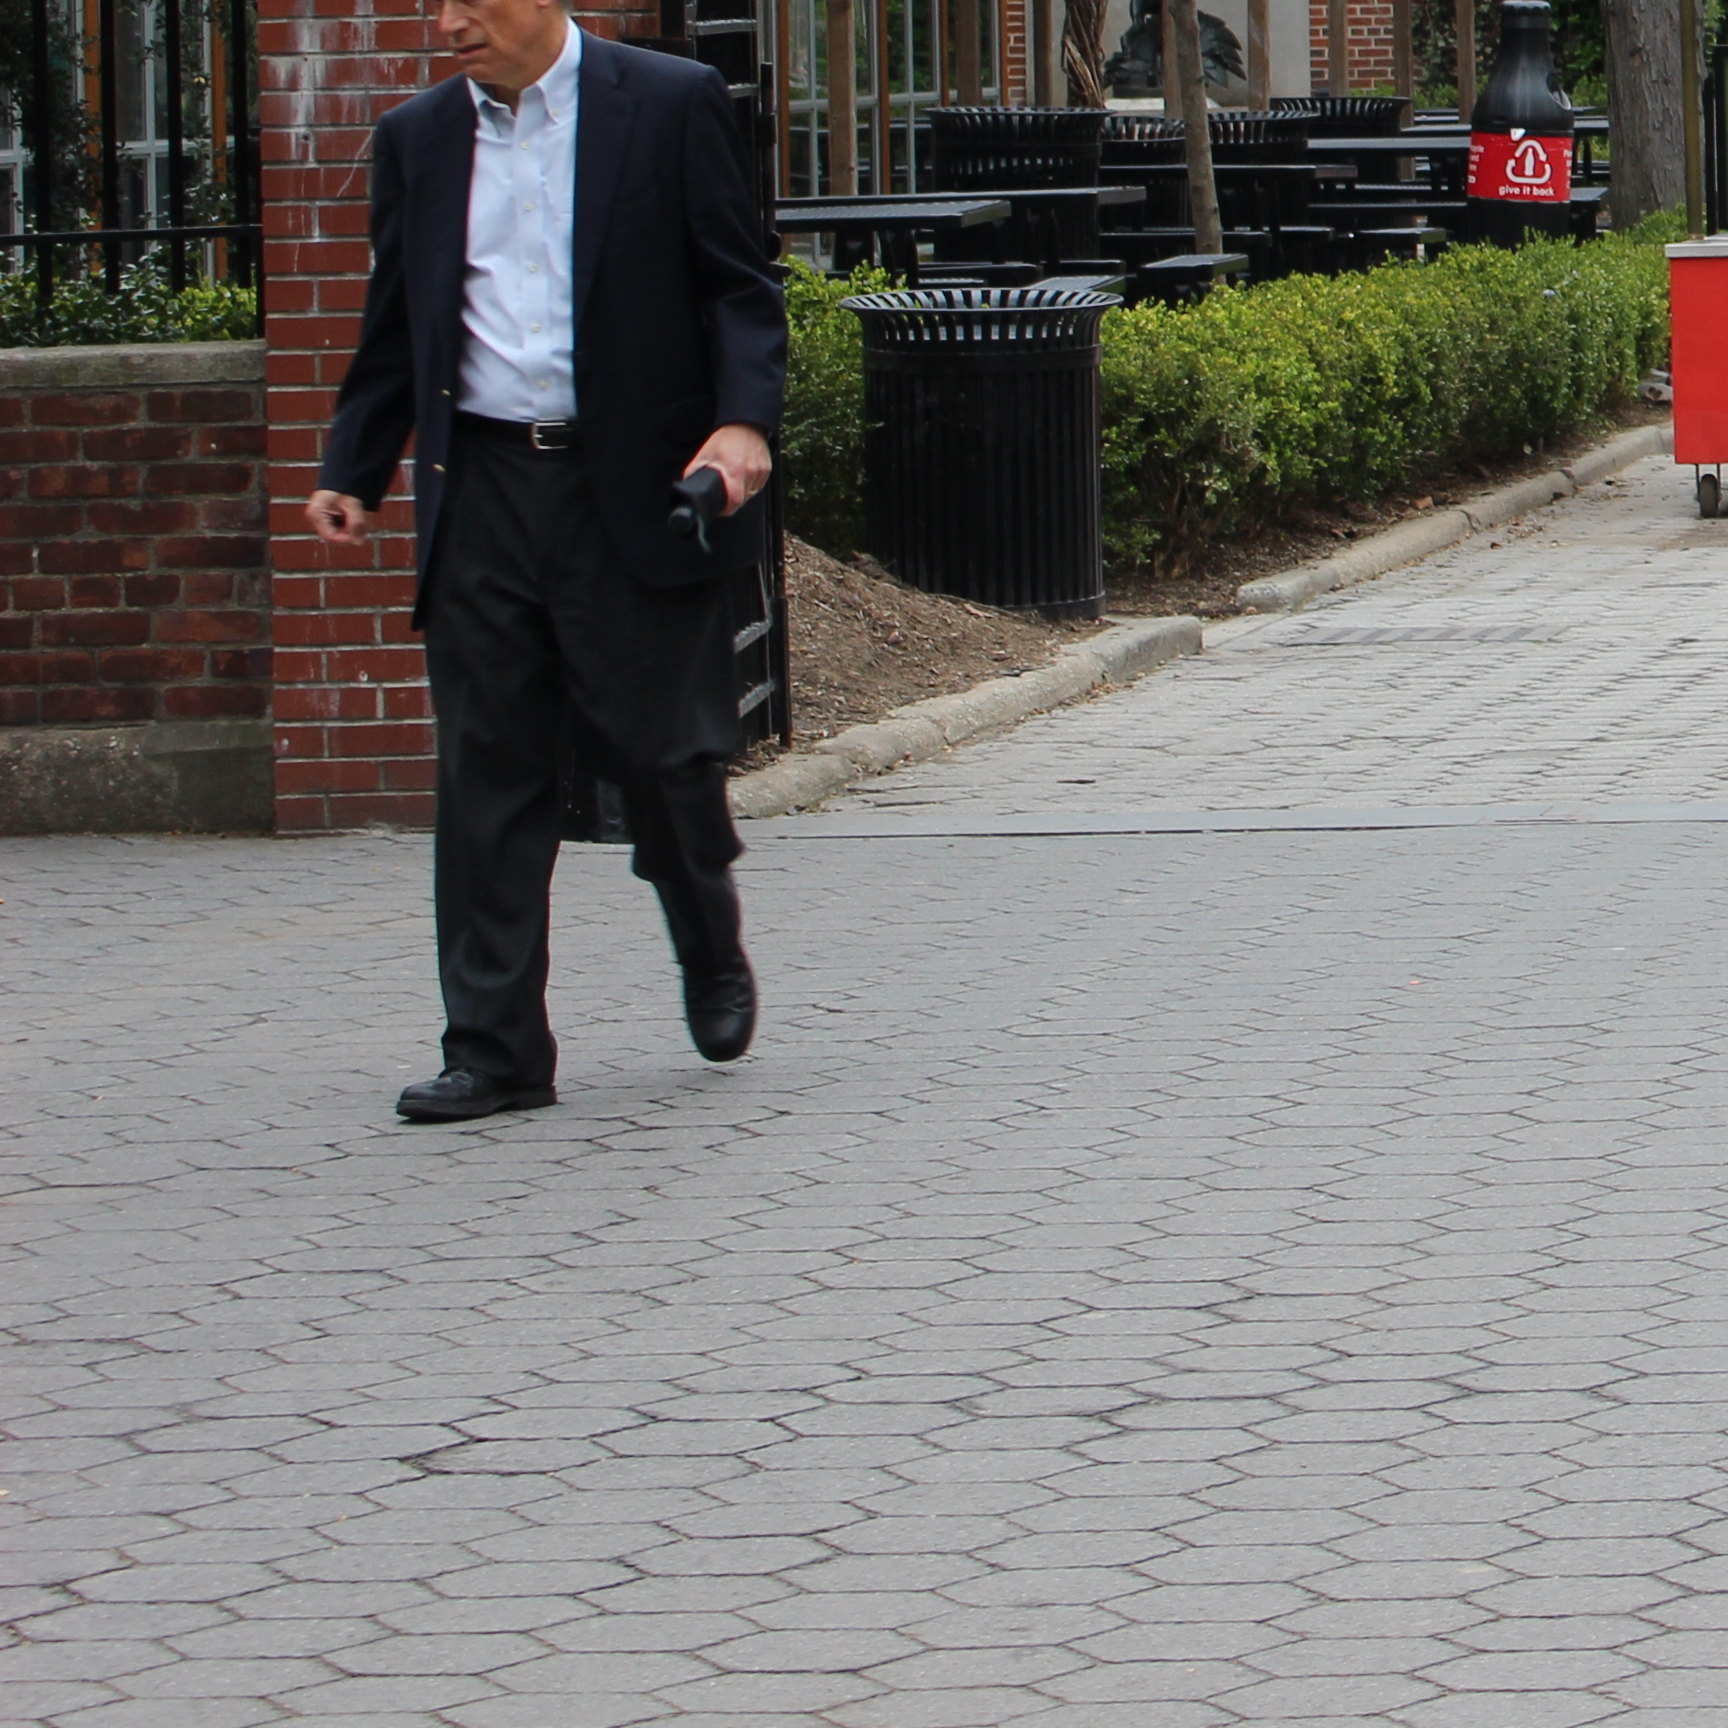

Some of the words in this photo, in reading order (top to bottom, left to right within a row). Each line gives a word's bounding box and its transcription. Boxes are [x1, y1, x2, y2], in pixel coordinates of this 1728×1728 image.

[1498, 184, 1521, 197] give
[1522, 185, 1531, 196] it
[1532, 185, 1556, 197] back
